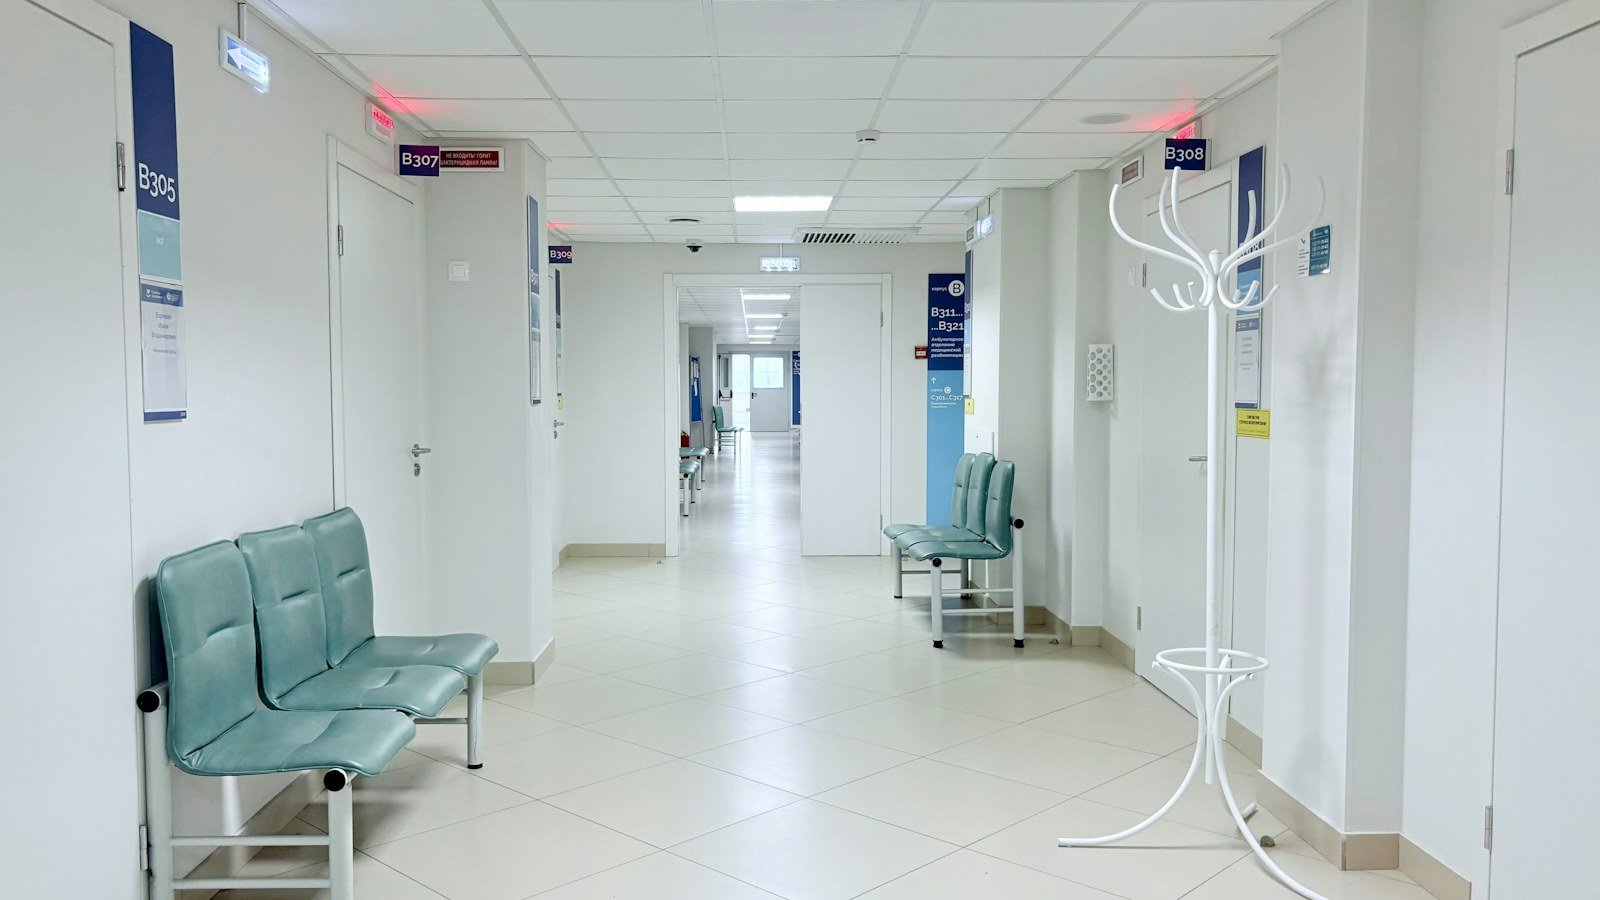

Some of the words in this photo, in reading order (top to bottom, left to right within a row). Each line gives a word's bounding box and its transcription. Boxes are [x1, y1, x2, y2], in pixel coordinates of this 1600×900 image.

[402, 152, 439, 168] B307
[1166, 147, 1204, 162] B308
[139, 162, 176, 203] B305
[550, 250, 572, 259] B309
